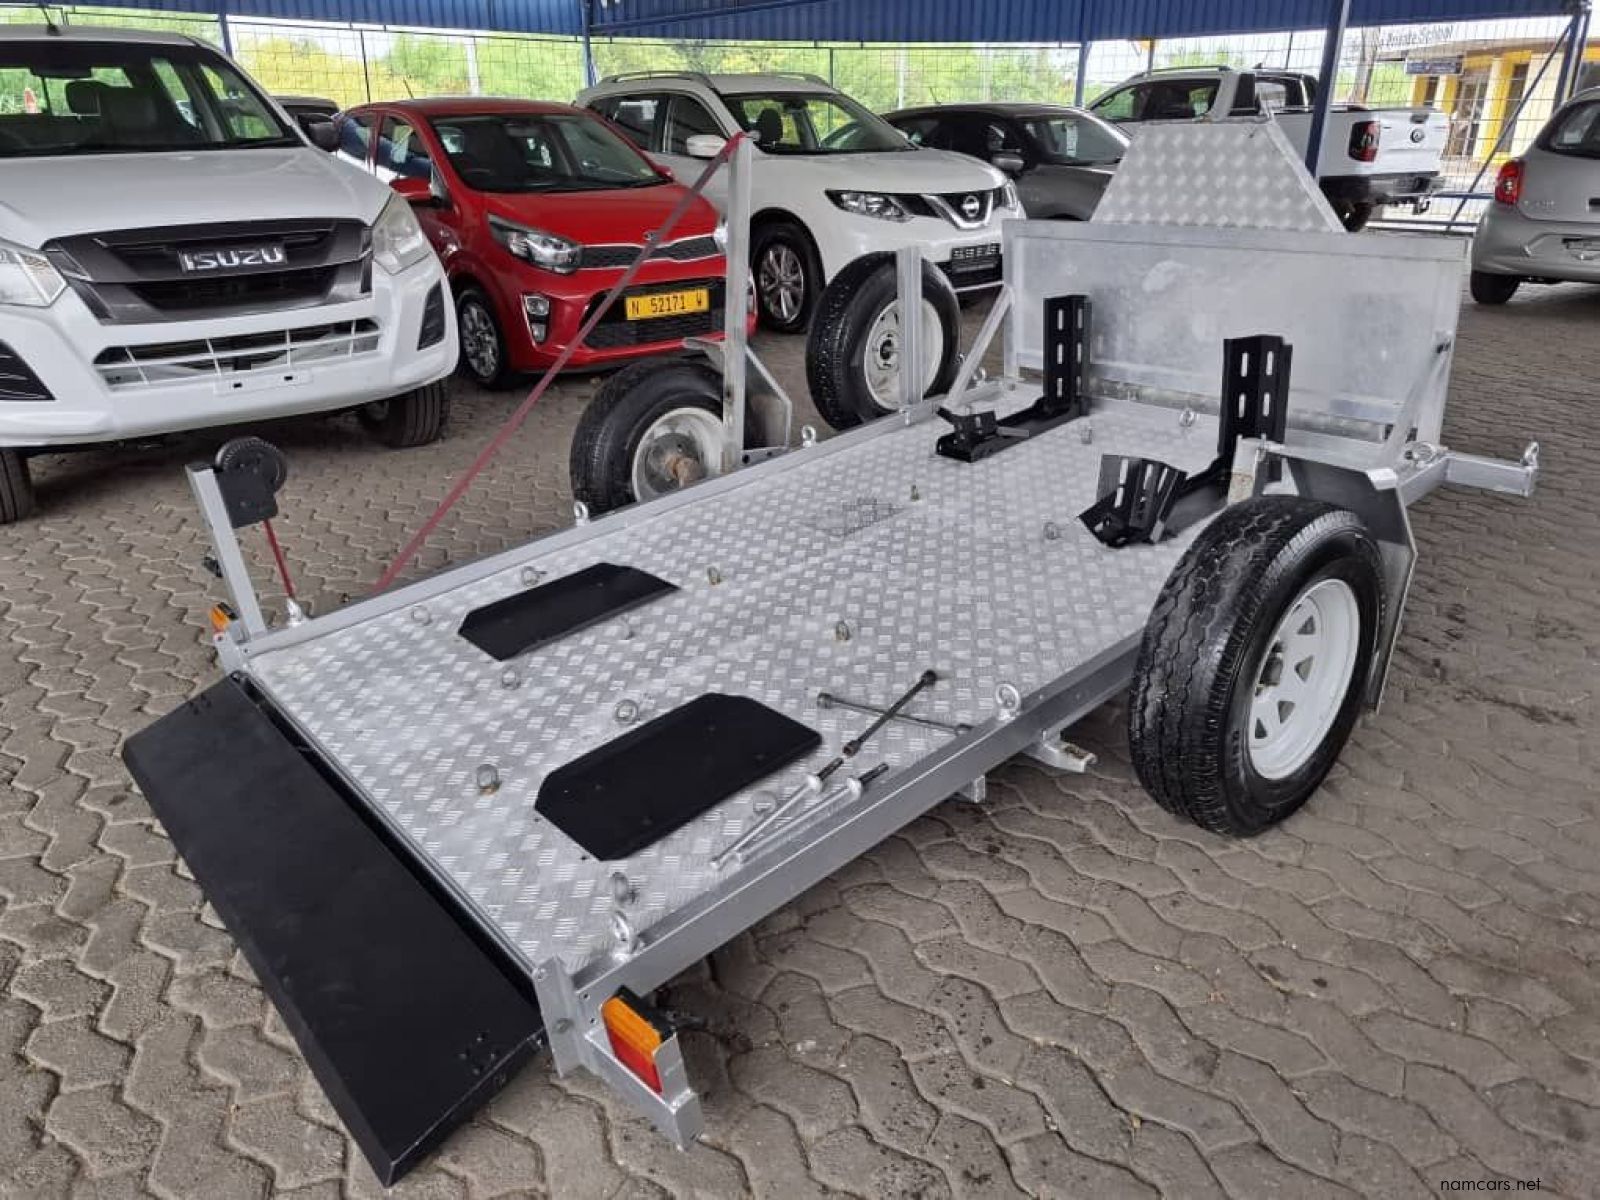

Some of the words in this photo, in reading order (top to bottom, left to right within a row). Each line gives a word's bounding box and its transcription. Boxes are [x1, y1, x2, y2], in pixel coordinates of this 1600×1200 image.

[182, 247, 284, 271] ISUZU
[630, 299, 640, 315] N
[650, 294, 687, 313] 52171
